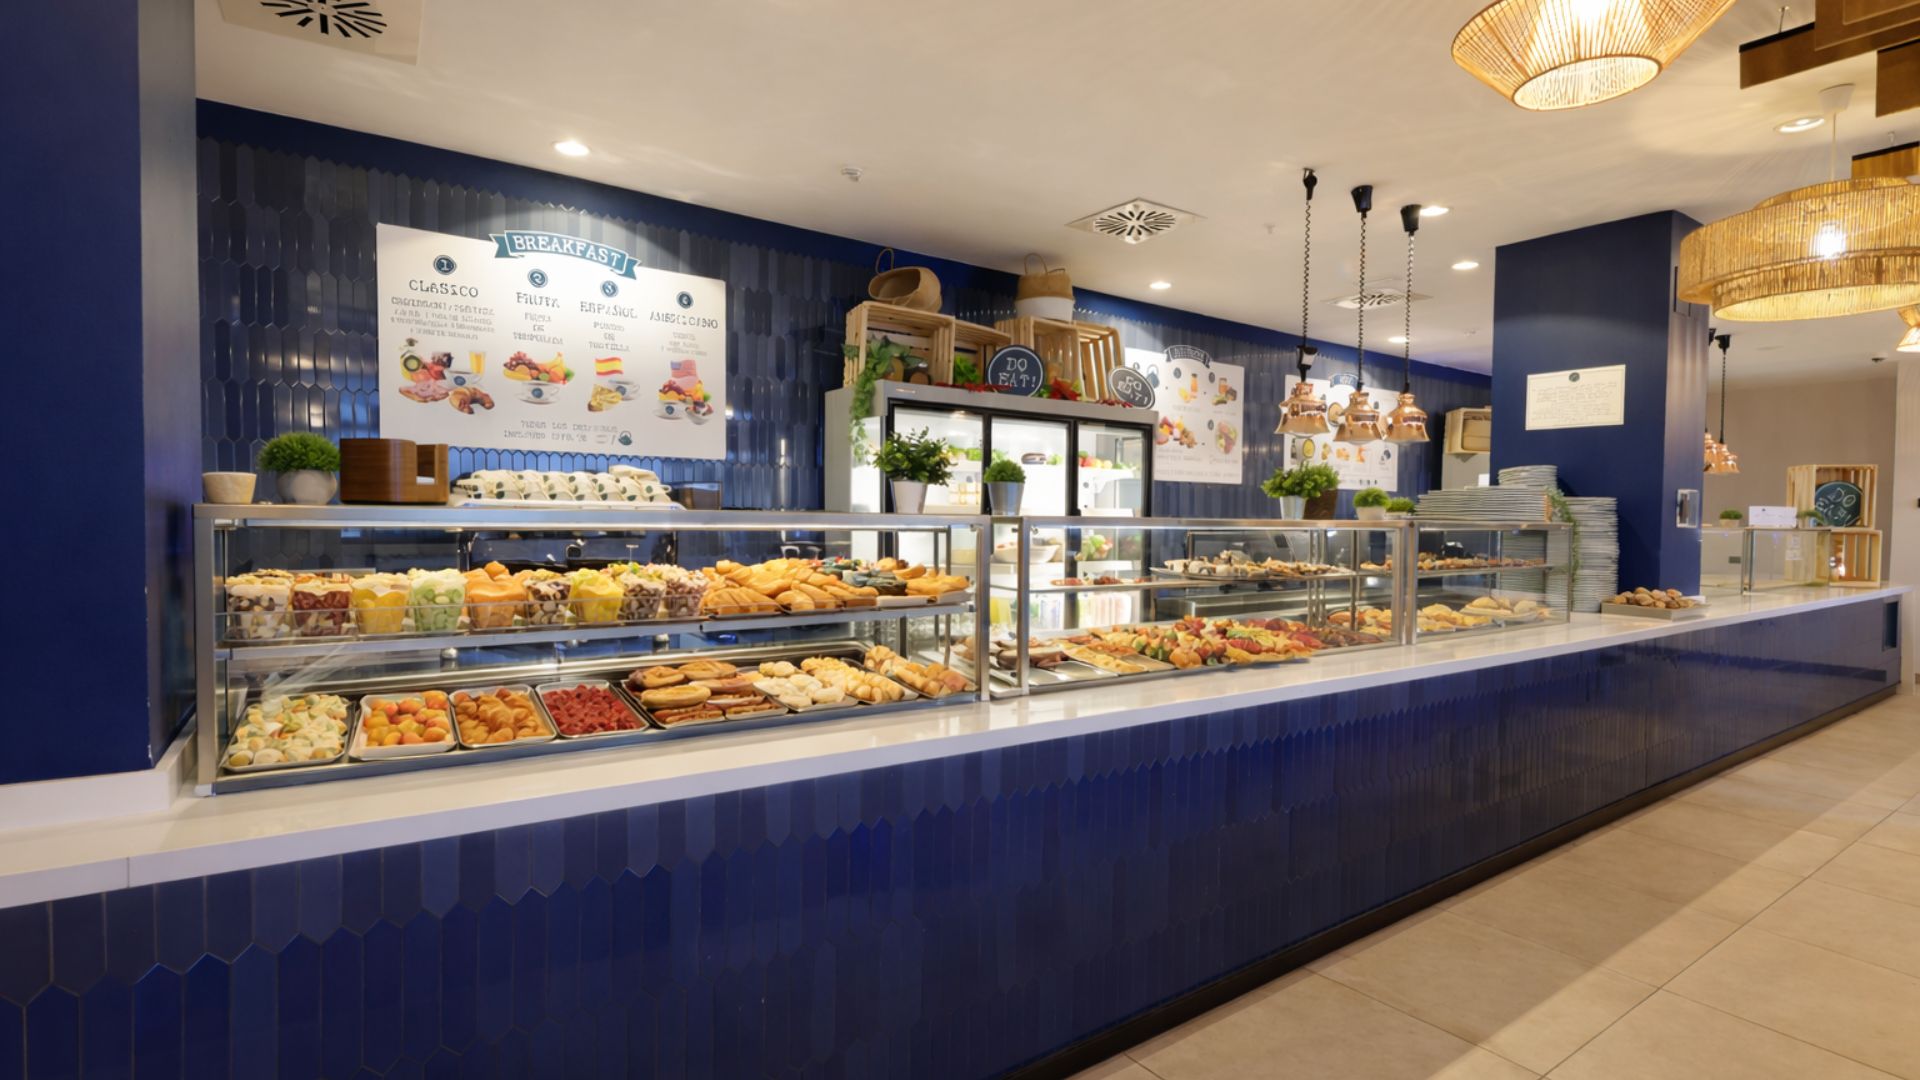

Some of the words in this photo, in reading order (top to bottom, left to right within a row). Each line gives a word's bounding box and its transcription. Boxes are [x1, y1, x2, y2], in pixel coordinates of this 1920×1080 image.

[512, 234, 621, 267] BREAKFAST
[439, 258, 451, 271] 1
[1006, 357, 1027, 372] DO
[998, 372, 1036, 388] EAT!
